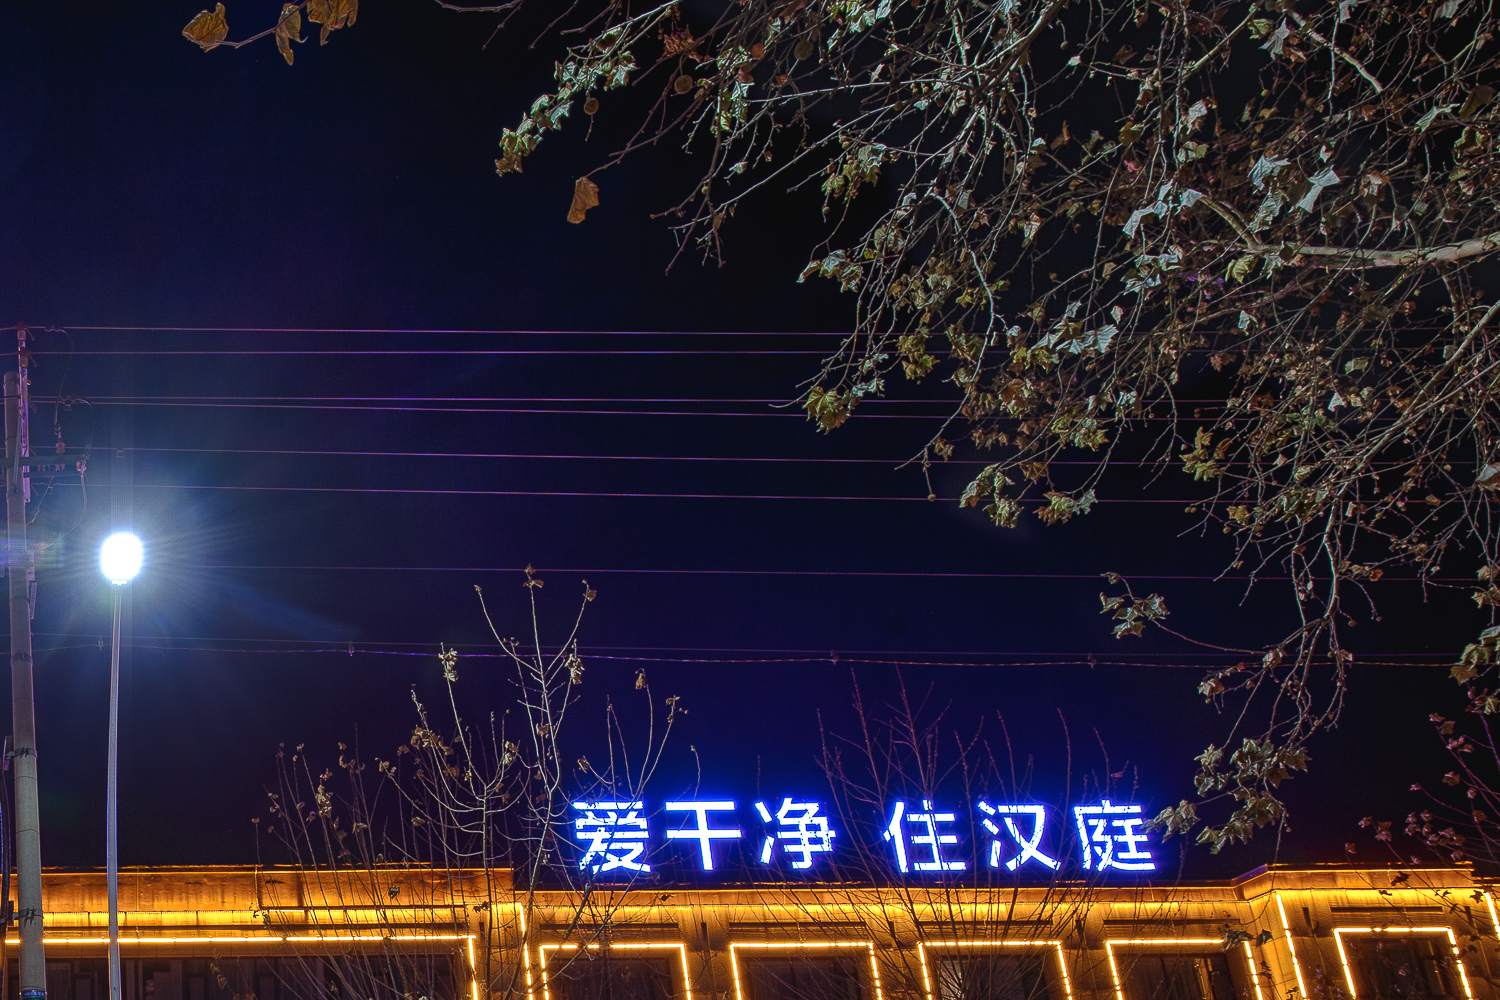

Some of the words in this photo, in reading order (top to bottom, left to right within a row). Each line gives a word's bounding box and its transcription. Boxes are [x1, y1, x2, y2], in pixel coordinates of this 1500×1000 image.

[572, 796, 837, 873] 爱干净
[882, 798, 1157, 873] 住汉庭
